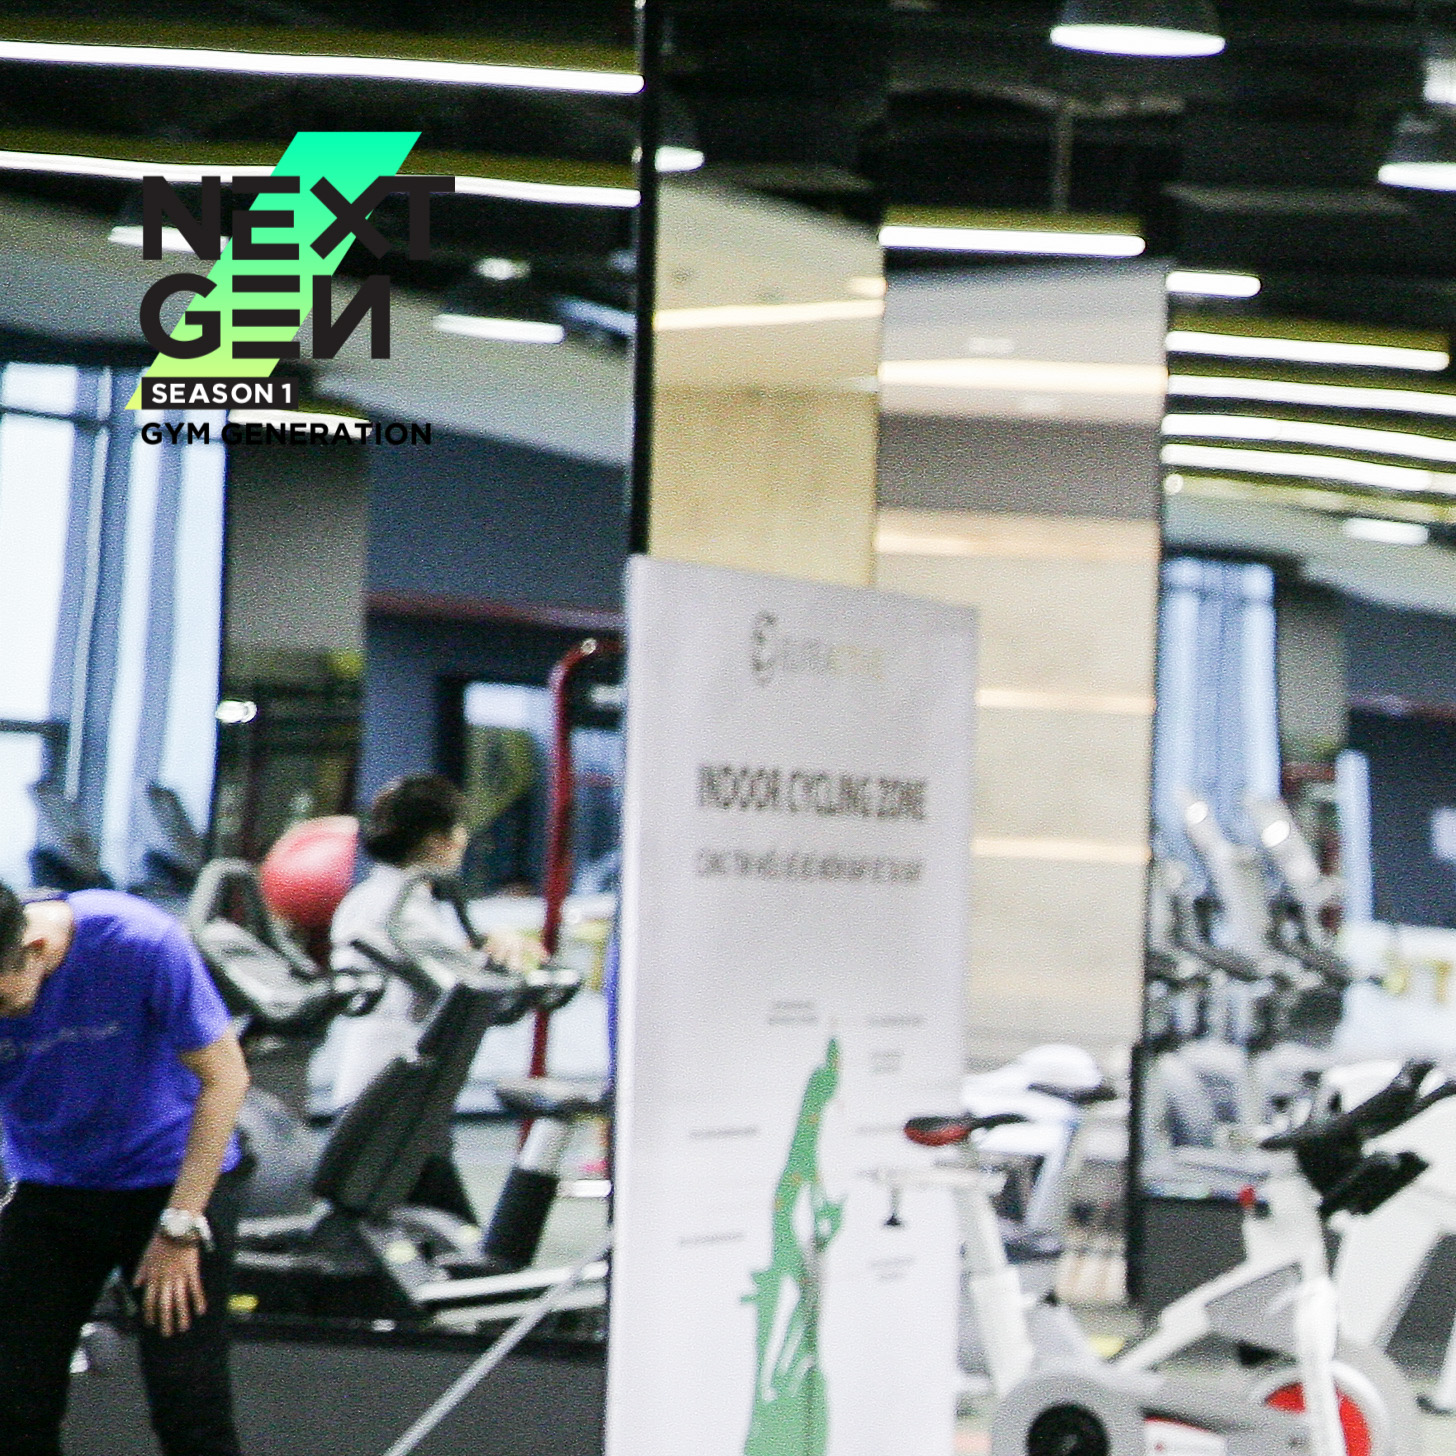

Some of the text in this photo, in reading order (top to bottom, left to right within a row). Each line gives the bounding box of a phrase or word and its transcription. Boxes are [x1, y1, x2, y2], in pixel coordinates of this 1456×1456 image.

[697, 763, 927, 823] INDOOR CYCLING ZONE
